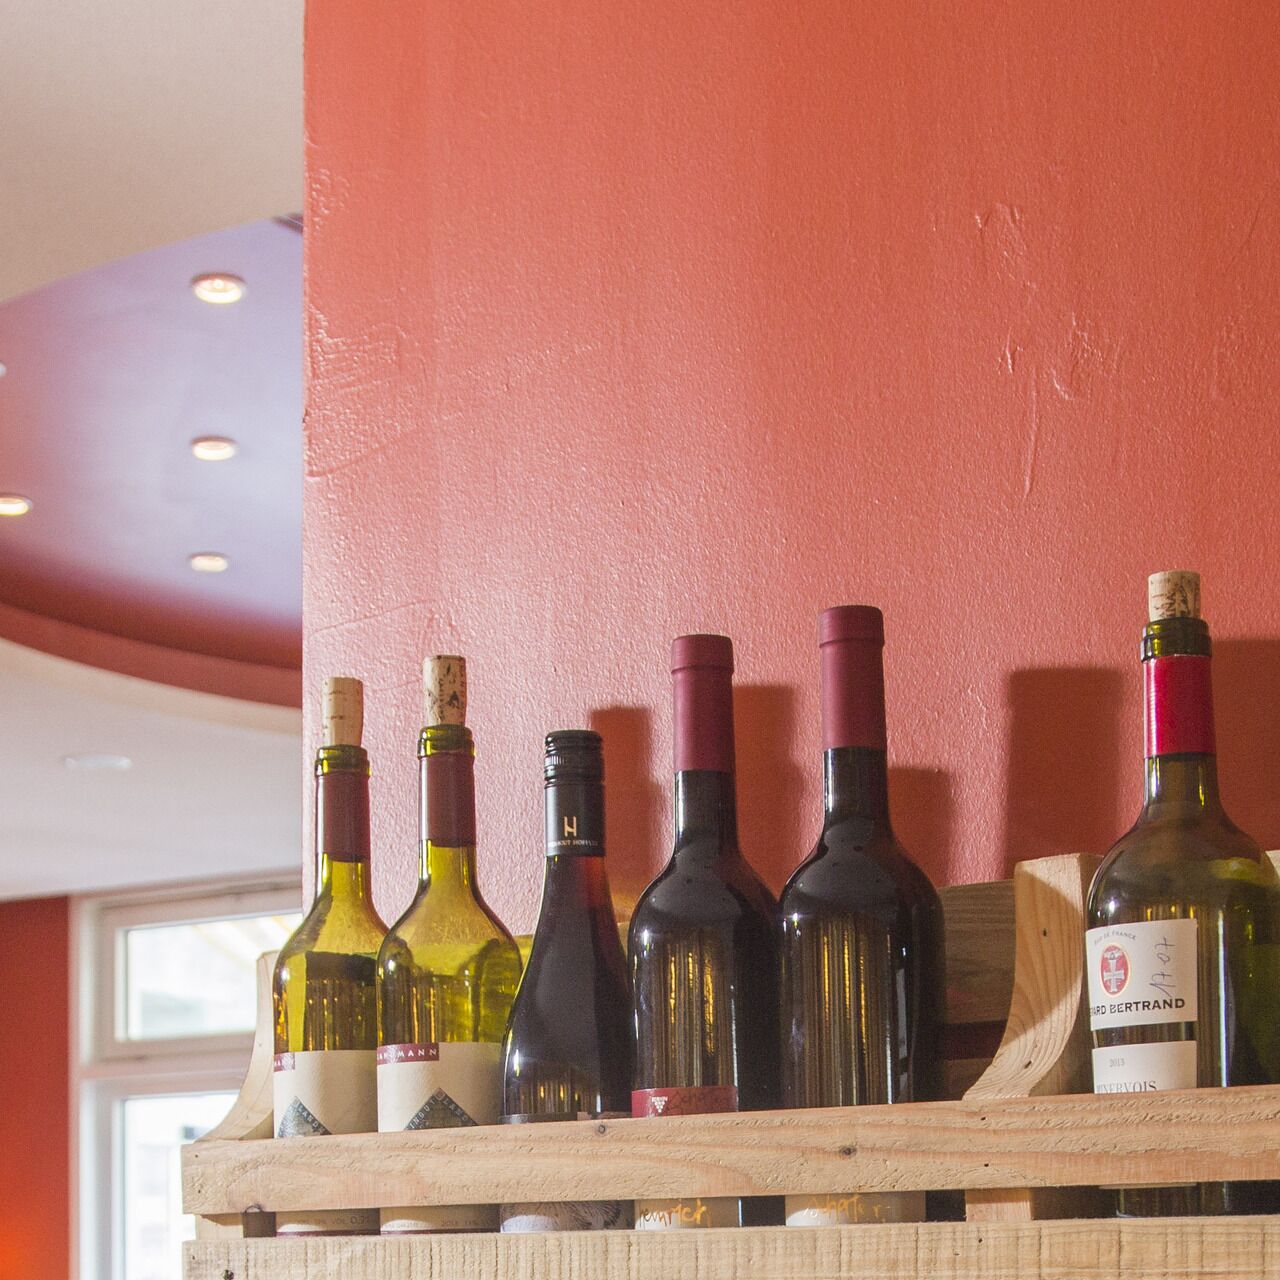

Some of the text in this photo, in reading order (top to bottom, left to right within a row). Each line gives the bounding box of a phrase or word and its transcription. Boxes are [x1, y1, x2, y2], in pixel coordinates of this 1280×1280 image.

[563, 815, 577, 838] H
[1112, 930, 1137, 941] FRANCE
[1108, 998, 1186, 1015] BERTRAND
